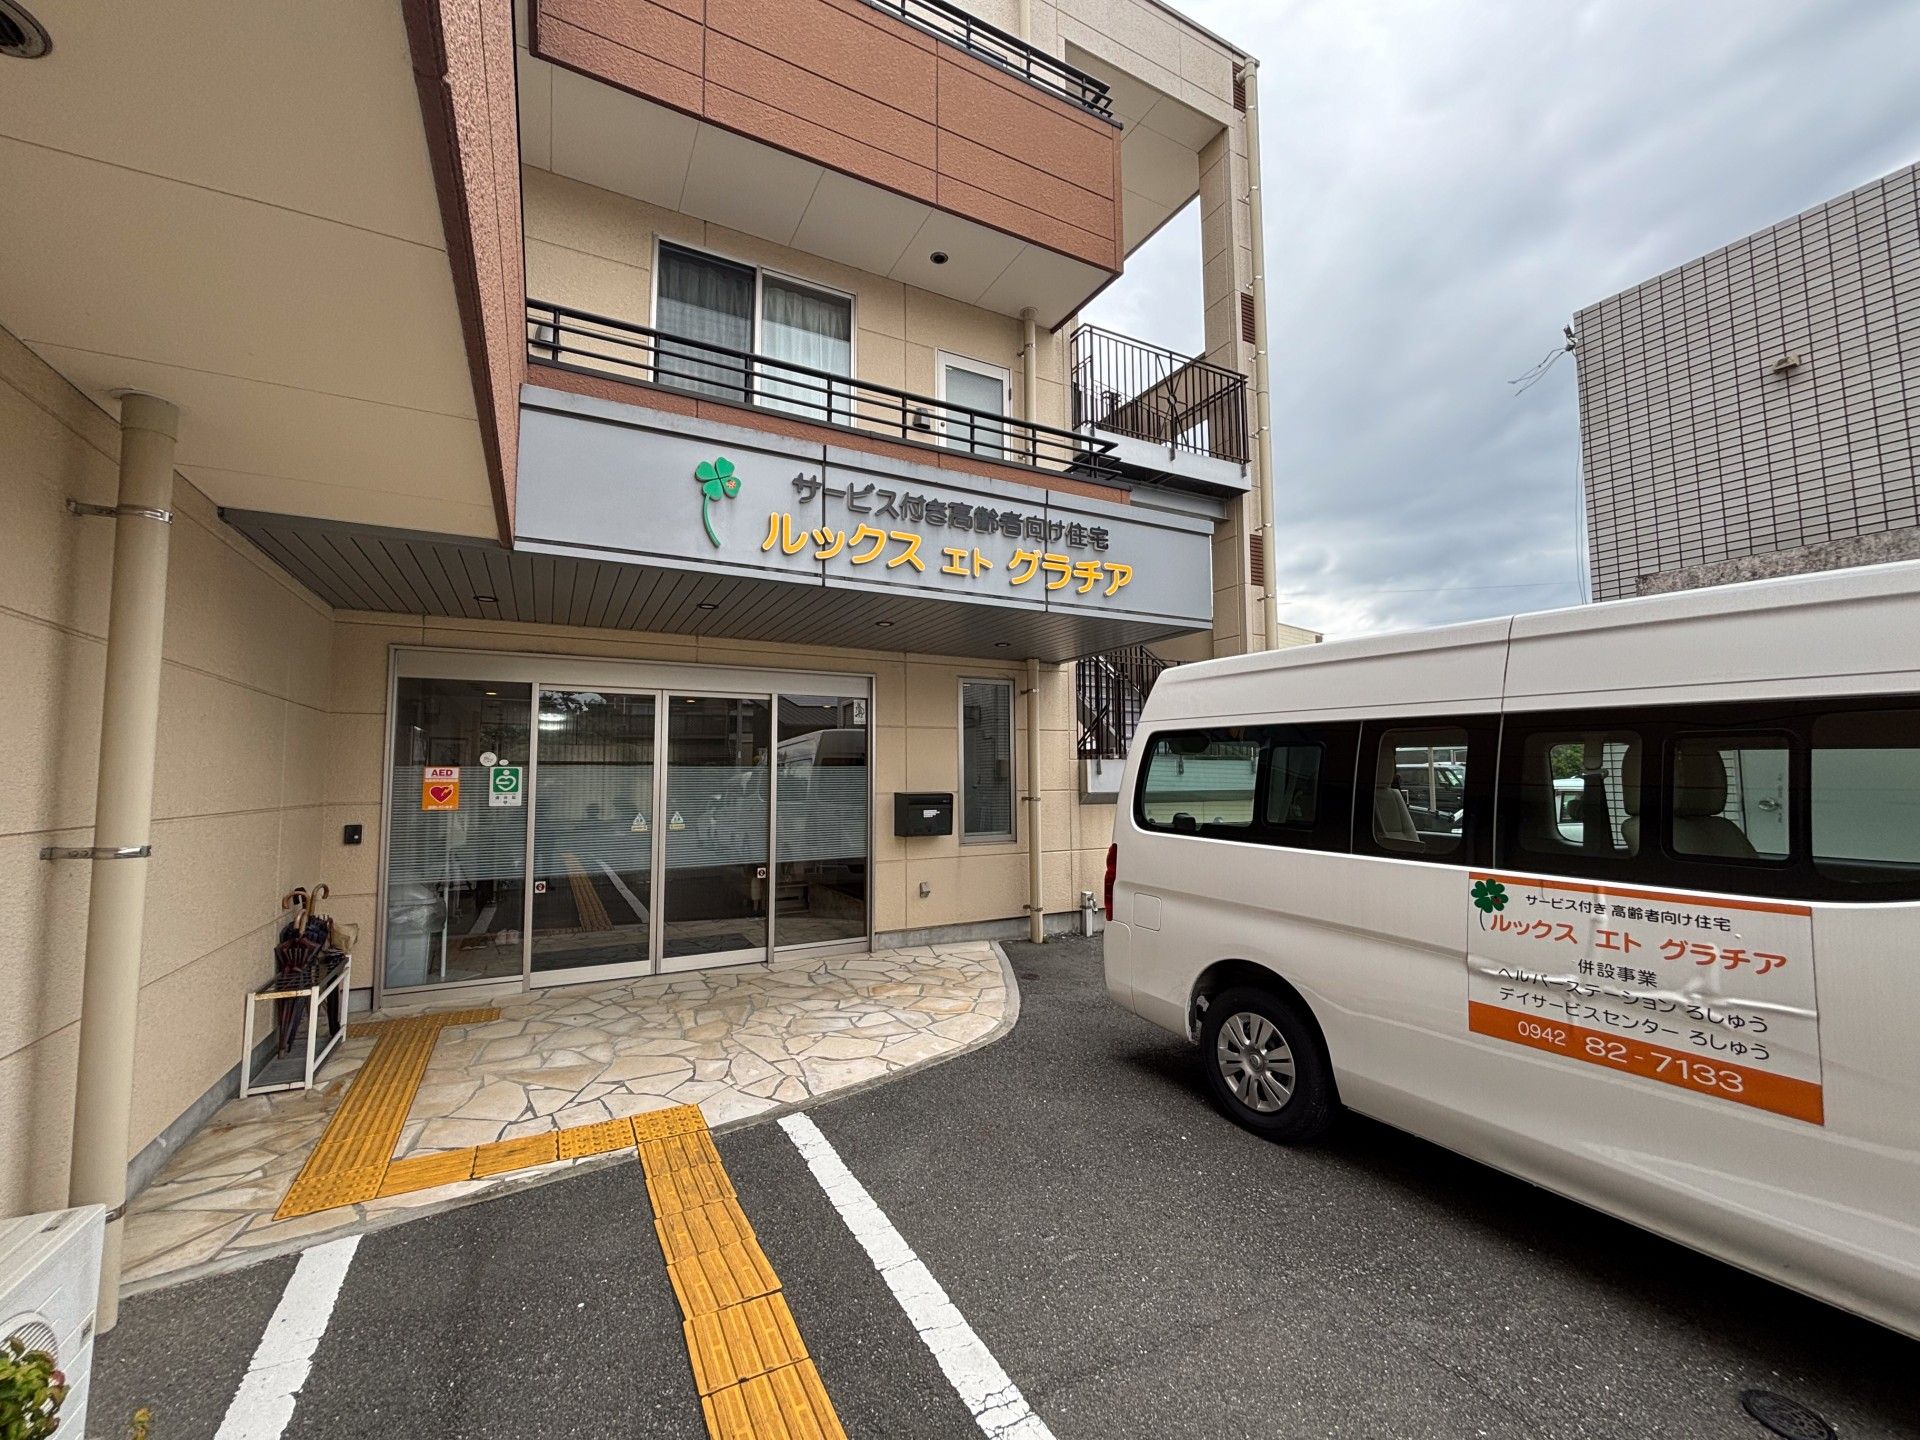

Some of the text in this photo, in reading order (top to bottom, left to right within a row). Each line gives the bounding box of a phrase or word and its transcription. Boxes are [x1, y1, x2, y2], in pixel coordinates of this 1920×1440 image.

[792, 472, 1109, 551] サービス付き高齢者向け住宅
[761, 512, 1133, 597] ルックス エト グラチア
[431, 769, 453, 777] AED
[1526, 894, 1731, 932] サービス付き 高齢者向け住宅
[1490, 914, 1787, 975] ルックス エト グラチア
[1578, 958, 1658, 988] 併設事業
[1500, 987, 1770, 1060] デイサービスセンター ろしゅう
[1518, 1021, 1566, 1047] 0942
[1686, 1004, 1768, 1033] ろしゅう
